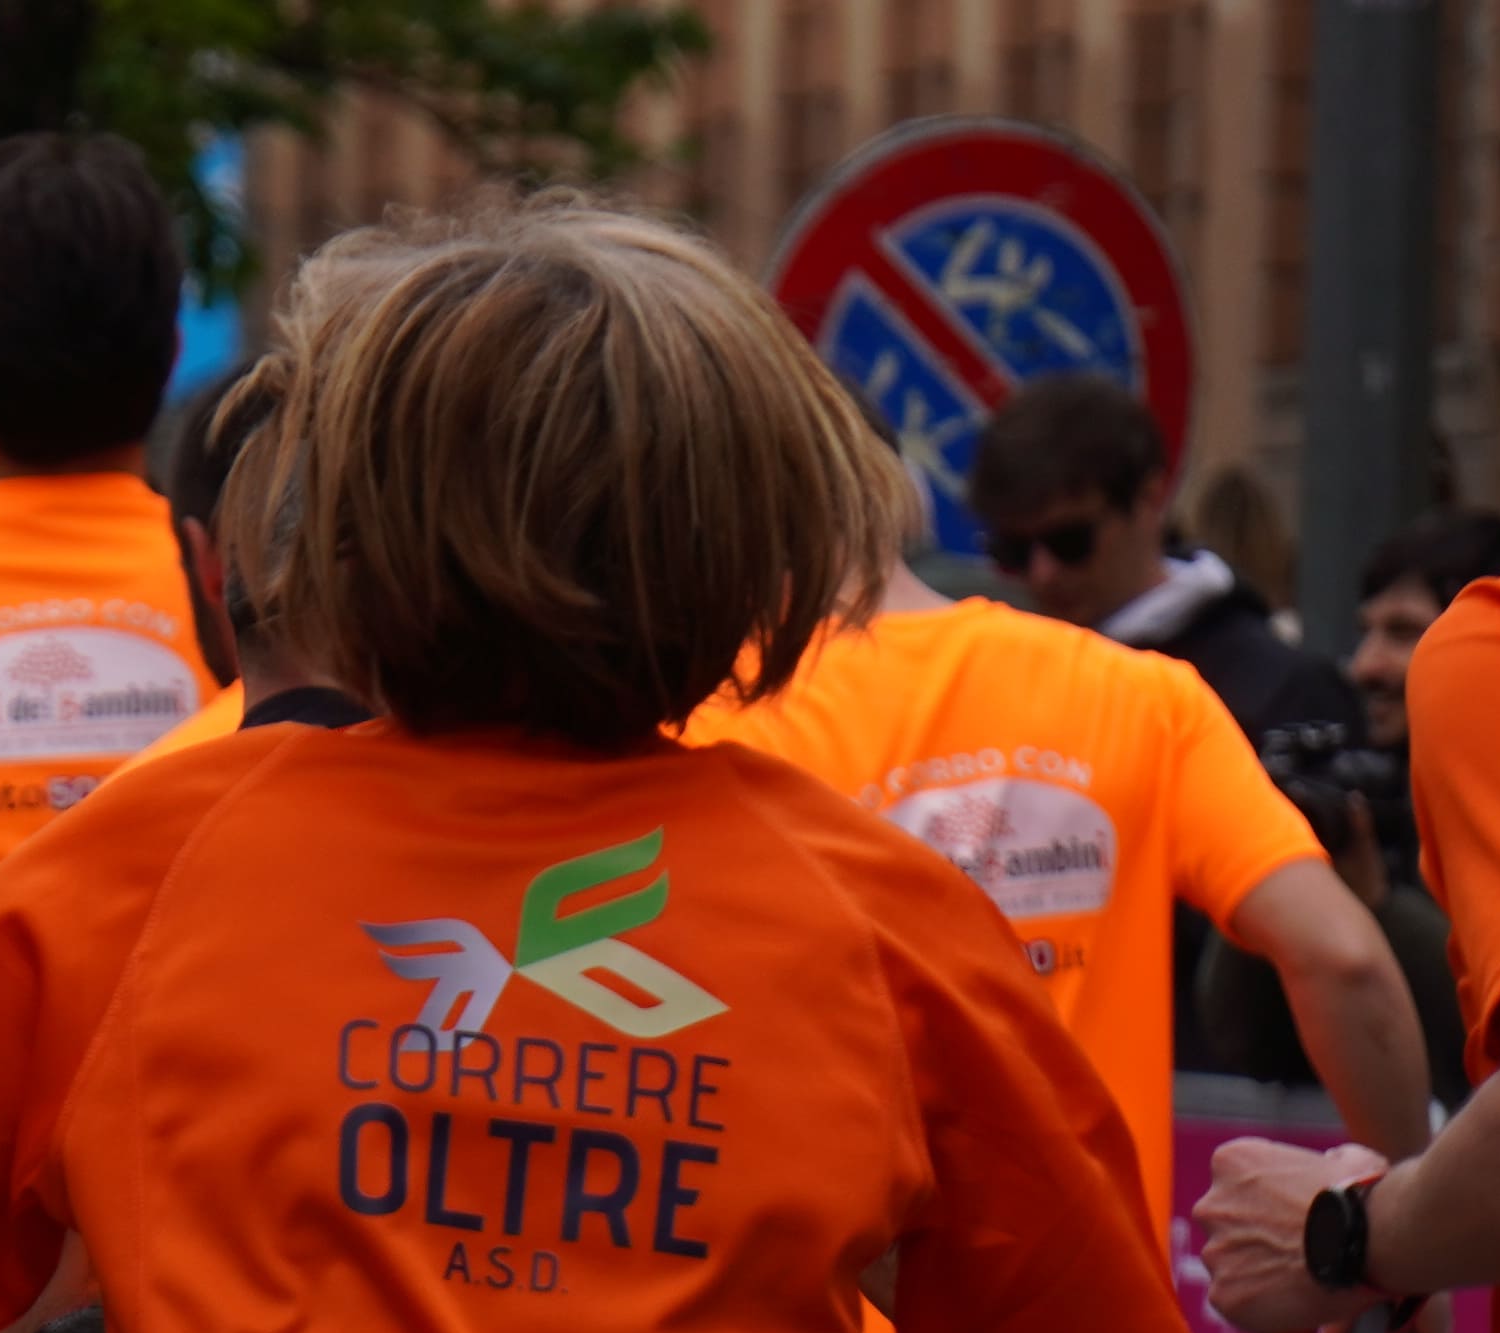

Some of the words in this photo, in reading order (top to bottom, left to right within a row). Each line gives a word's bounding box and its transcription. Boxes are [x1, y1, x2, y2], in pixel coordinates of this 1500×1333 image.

[100, 599, 180, 641] CON
[337, 1019, 731, 1132] CORRERE
[339, 1102, 720, 1260] OLTRE
[443, 1240, 570, 1294] A.S.D.
